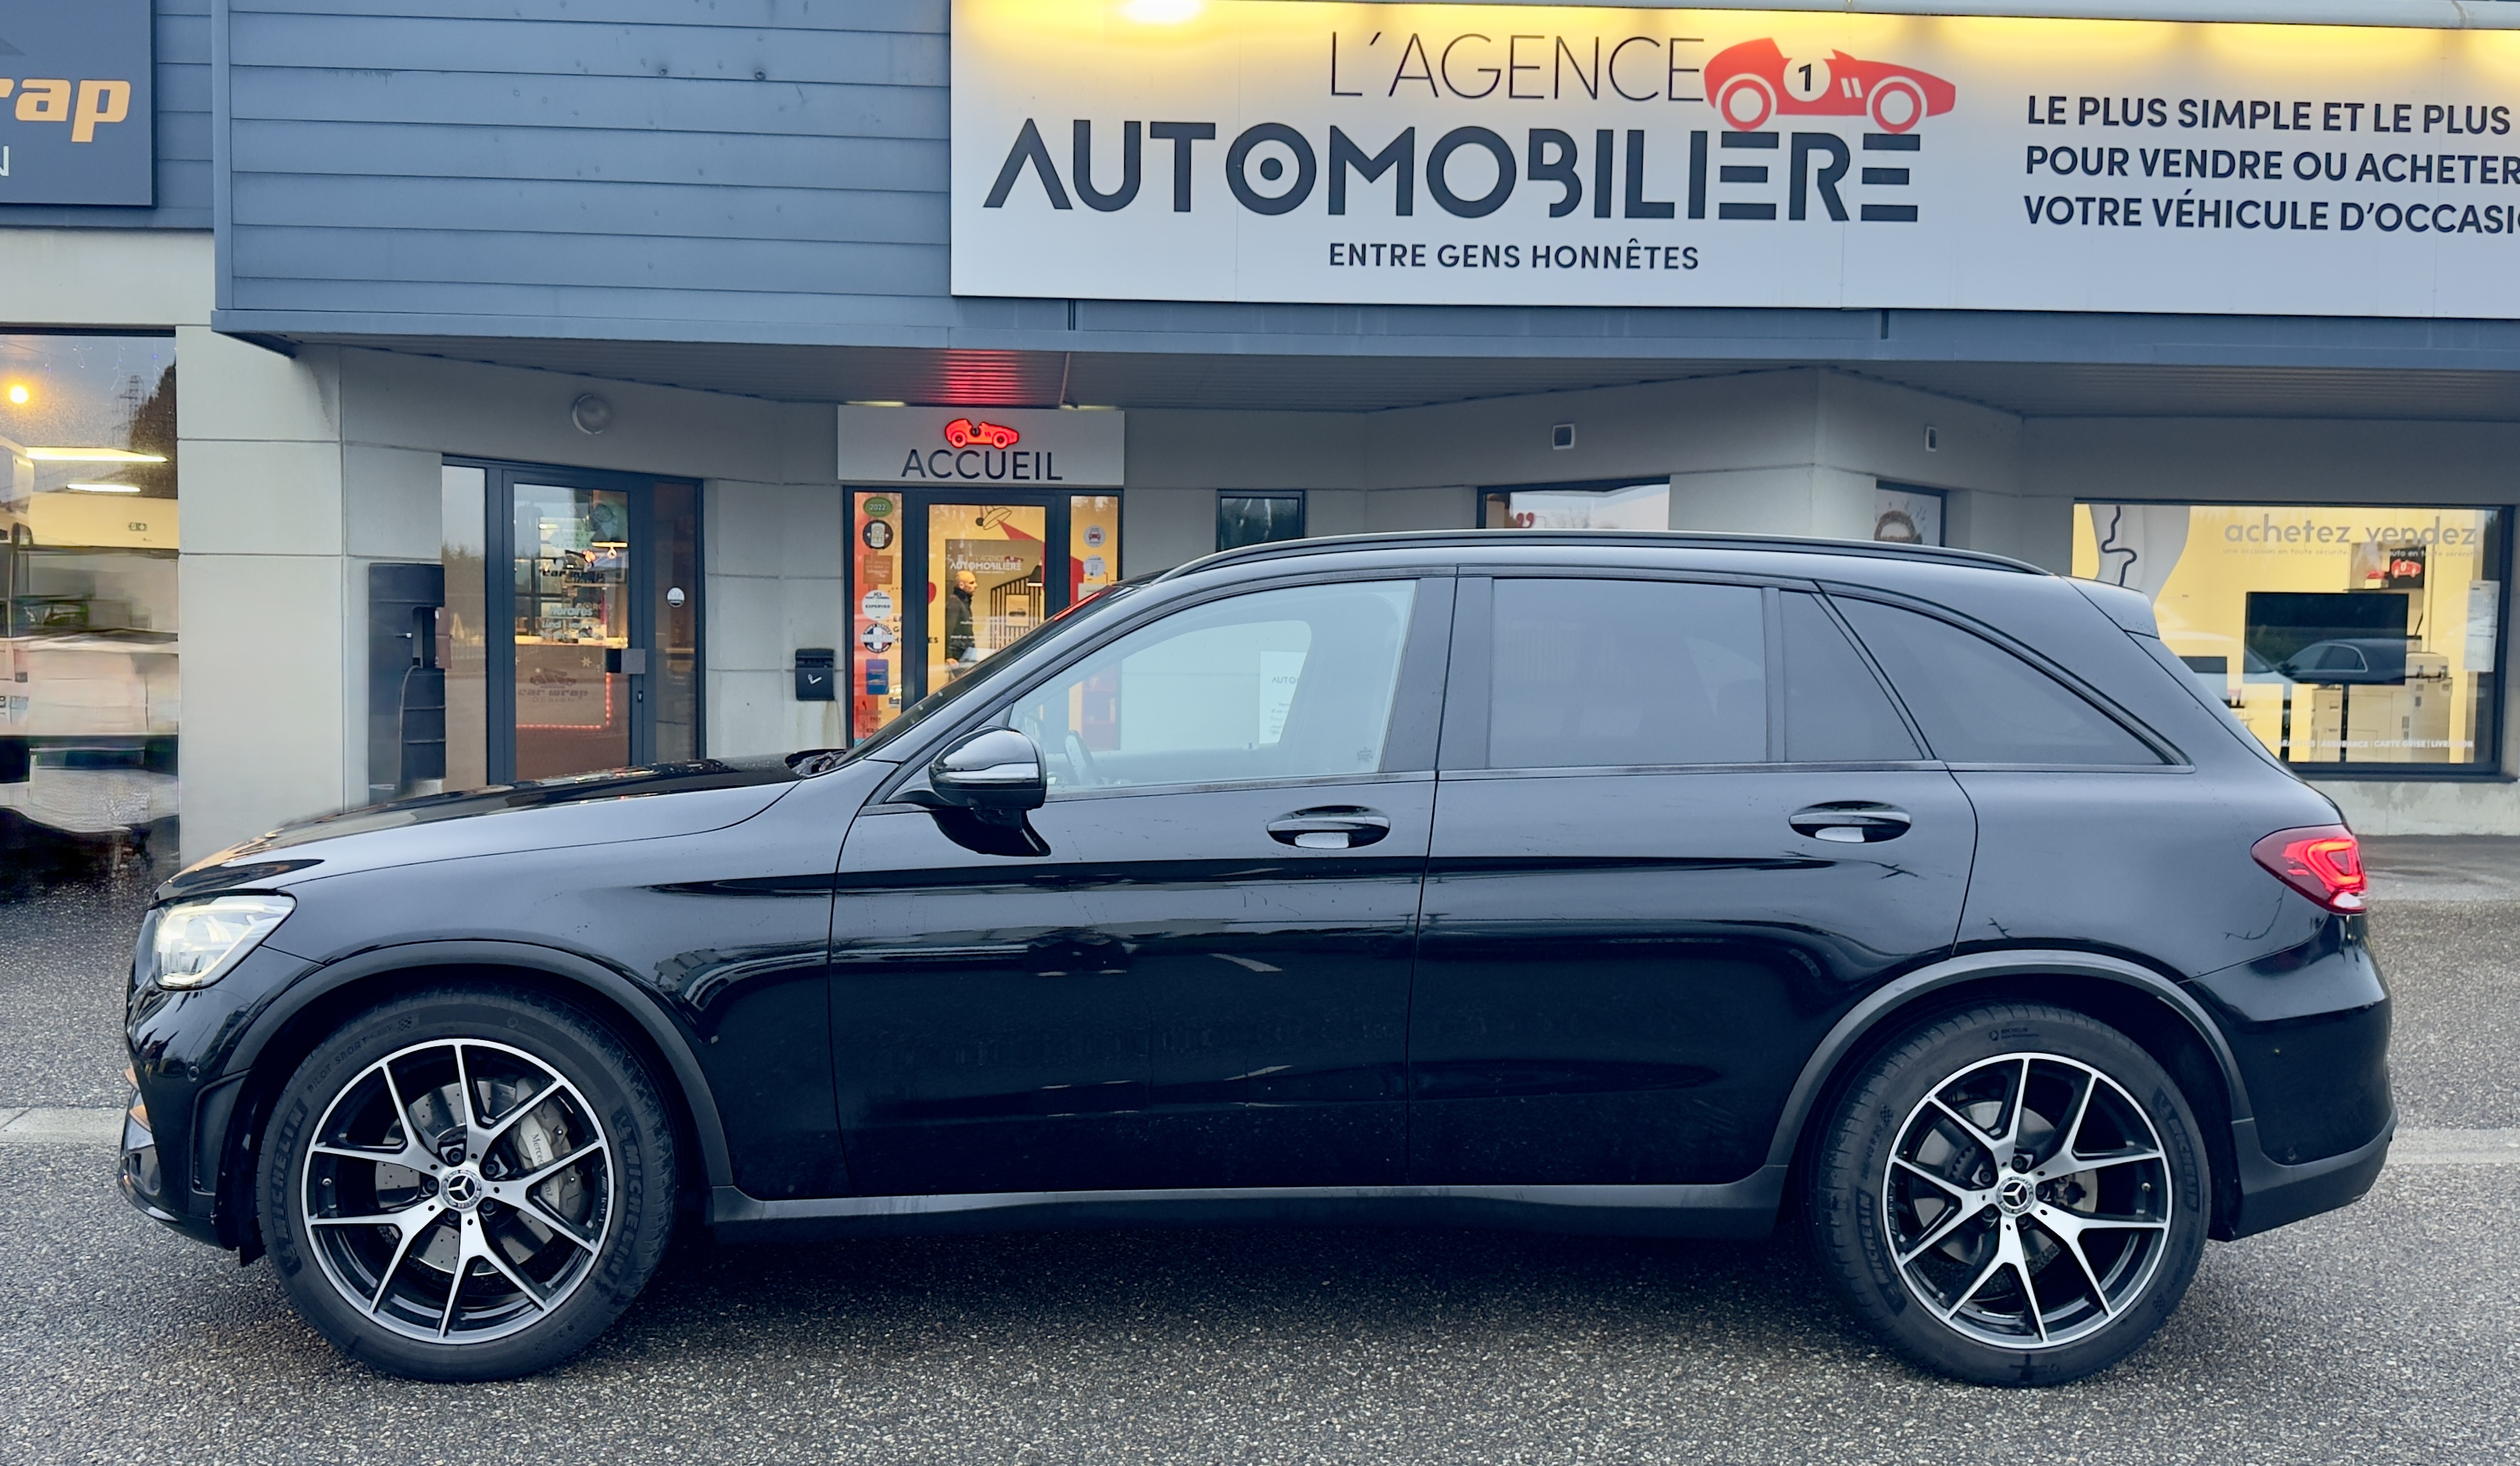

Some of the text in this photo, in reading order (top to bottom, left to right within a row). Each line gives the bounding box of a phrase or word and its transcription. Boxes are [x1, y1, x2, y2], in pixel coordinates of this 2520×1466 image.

[1331, 31, 1705, 102] L'AGENCE
[1798, 63, 1813, 92] 1
[2028, 95, 2511, 135] LE PLUS SIMPLE ET LE PLUS
[983, 117, 1921, 223] AUTOMOBILIERE
[2026, 145, 2520, 185] POUR VENDRE OU ACHETER
[2023, 188, 2520, 234] VOTRE VÉHICULE D'OCCASI
[1329, 238, 1700, 270] ENTRE GENS HONNÊTES
[901, 449, 1063, 480] ACCUEIL
[2224, 514, 2477, 546] achetez vendez
[549, 605, 593, 615] Horaires
[549, 689, 588, 700] wrap
[307, 1036, 368, 1093] PILOT SPORT
[1869, 1137, 1877, 1146] R
[1873, 1125, 1883, 1138] 20
[272, 1107, 303, 1238] MICHELIN
[2169, 1119, 2198, 1208] MICHELIN
[610, 1145, 642, 1275] MICHELIN
[1860, 1194, 1890, 1285] MICHELIN
